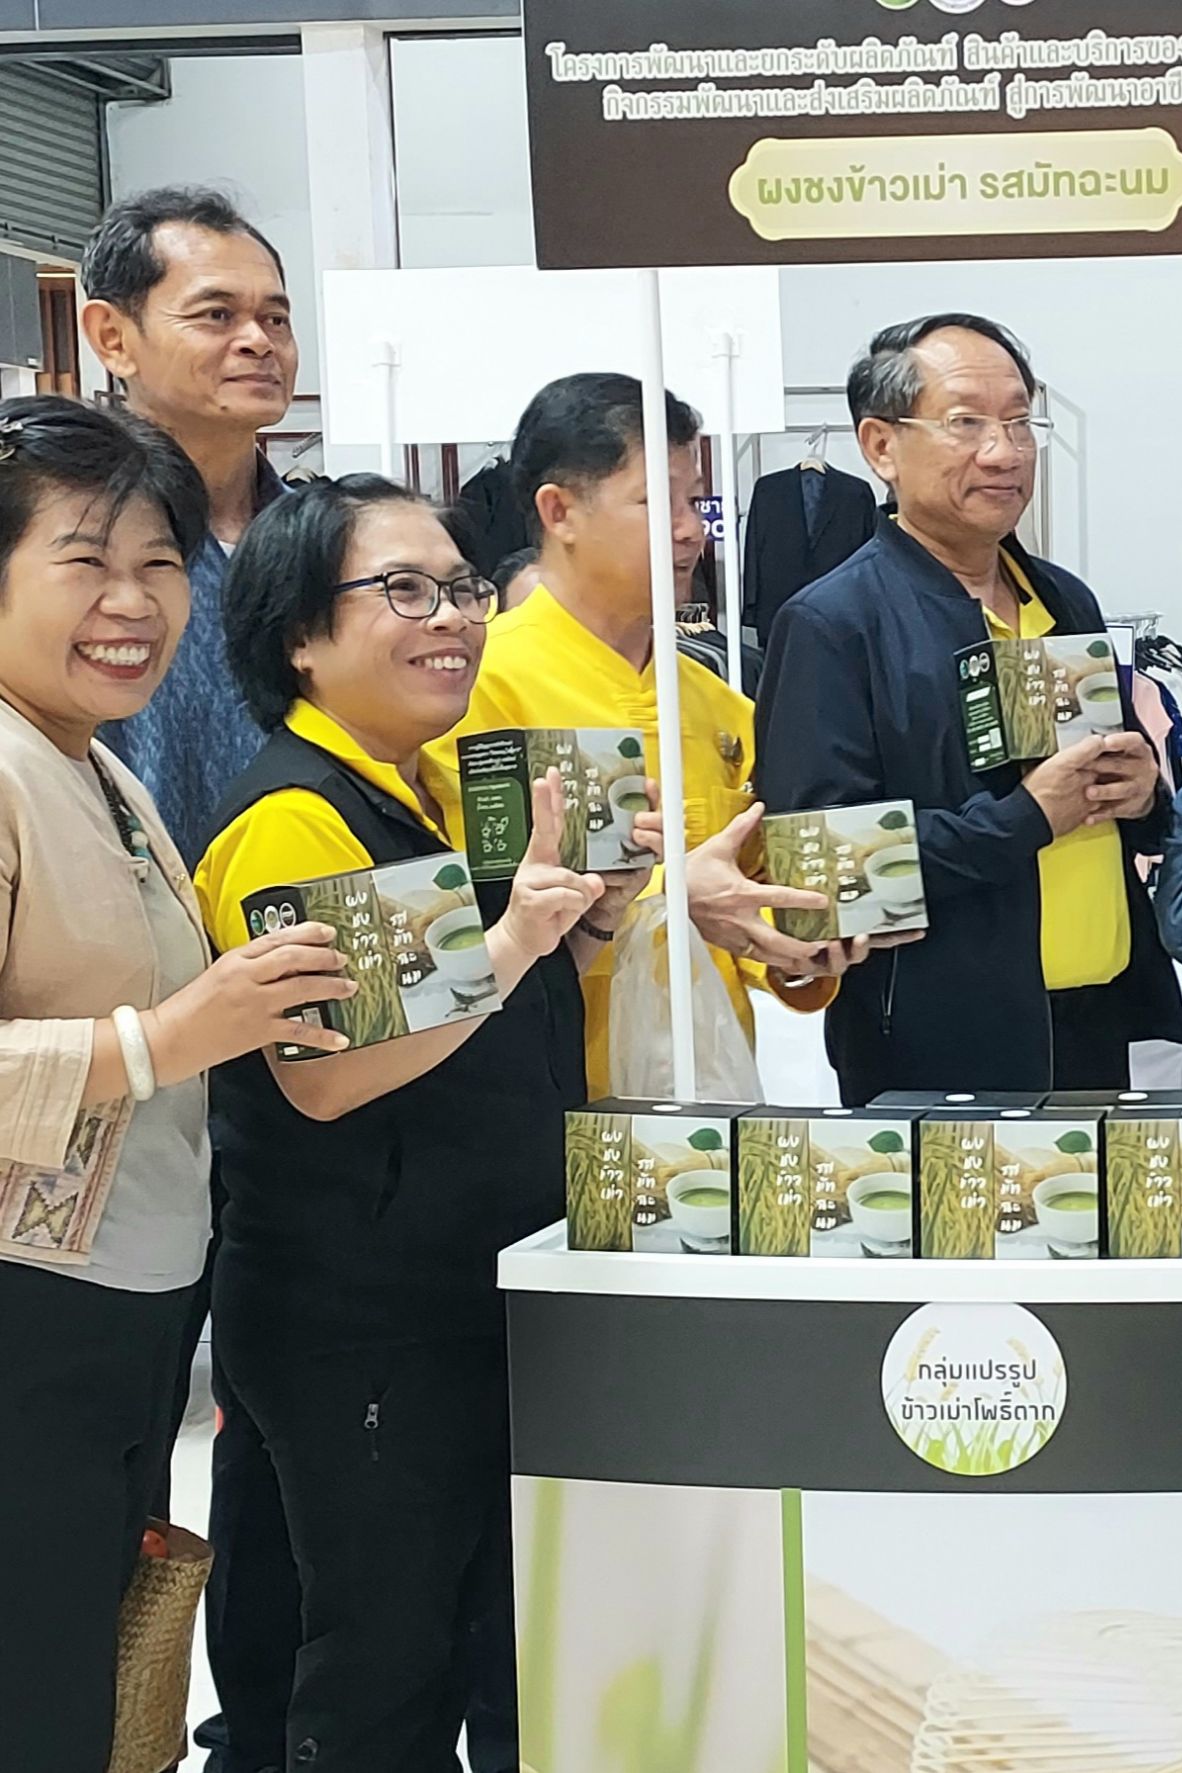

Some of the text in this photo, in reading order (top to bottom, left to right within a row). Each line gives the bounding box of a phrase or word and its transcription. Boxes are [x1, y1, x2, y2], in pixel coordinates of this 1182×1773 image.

[546, 32, 959, 81] โครงการพัฒนาและยกระดับผลิตภัณฑ์
[603, 72, 1000, 121] กิจกรรมพัฒนาและส่งเสริมผลิตภัณฑ์
[757, 161, 1170, 206] ผงชงข้าวเม่า รสมัทฉะนม
[918, 1356, 1036, 1388] กลุ่มแปรรูป
[901, 1391, 1056, 1421] ข้าวเม่าโพธิ์ตาก
